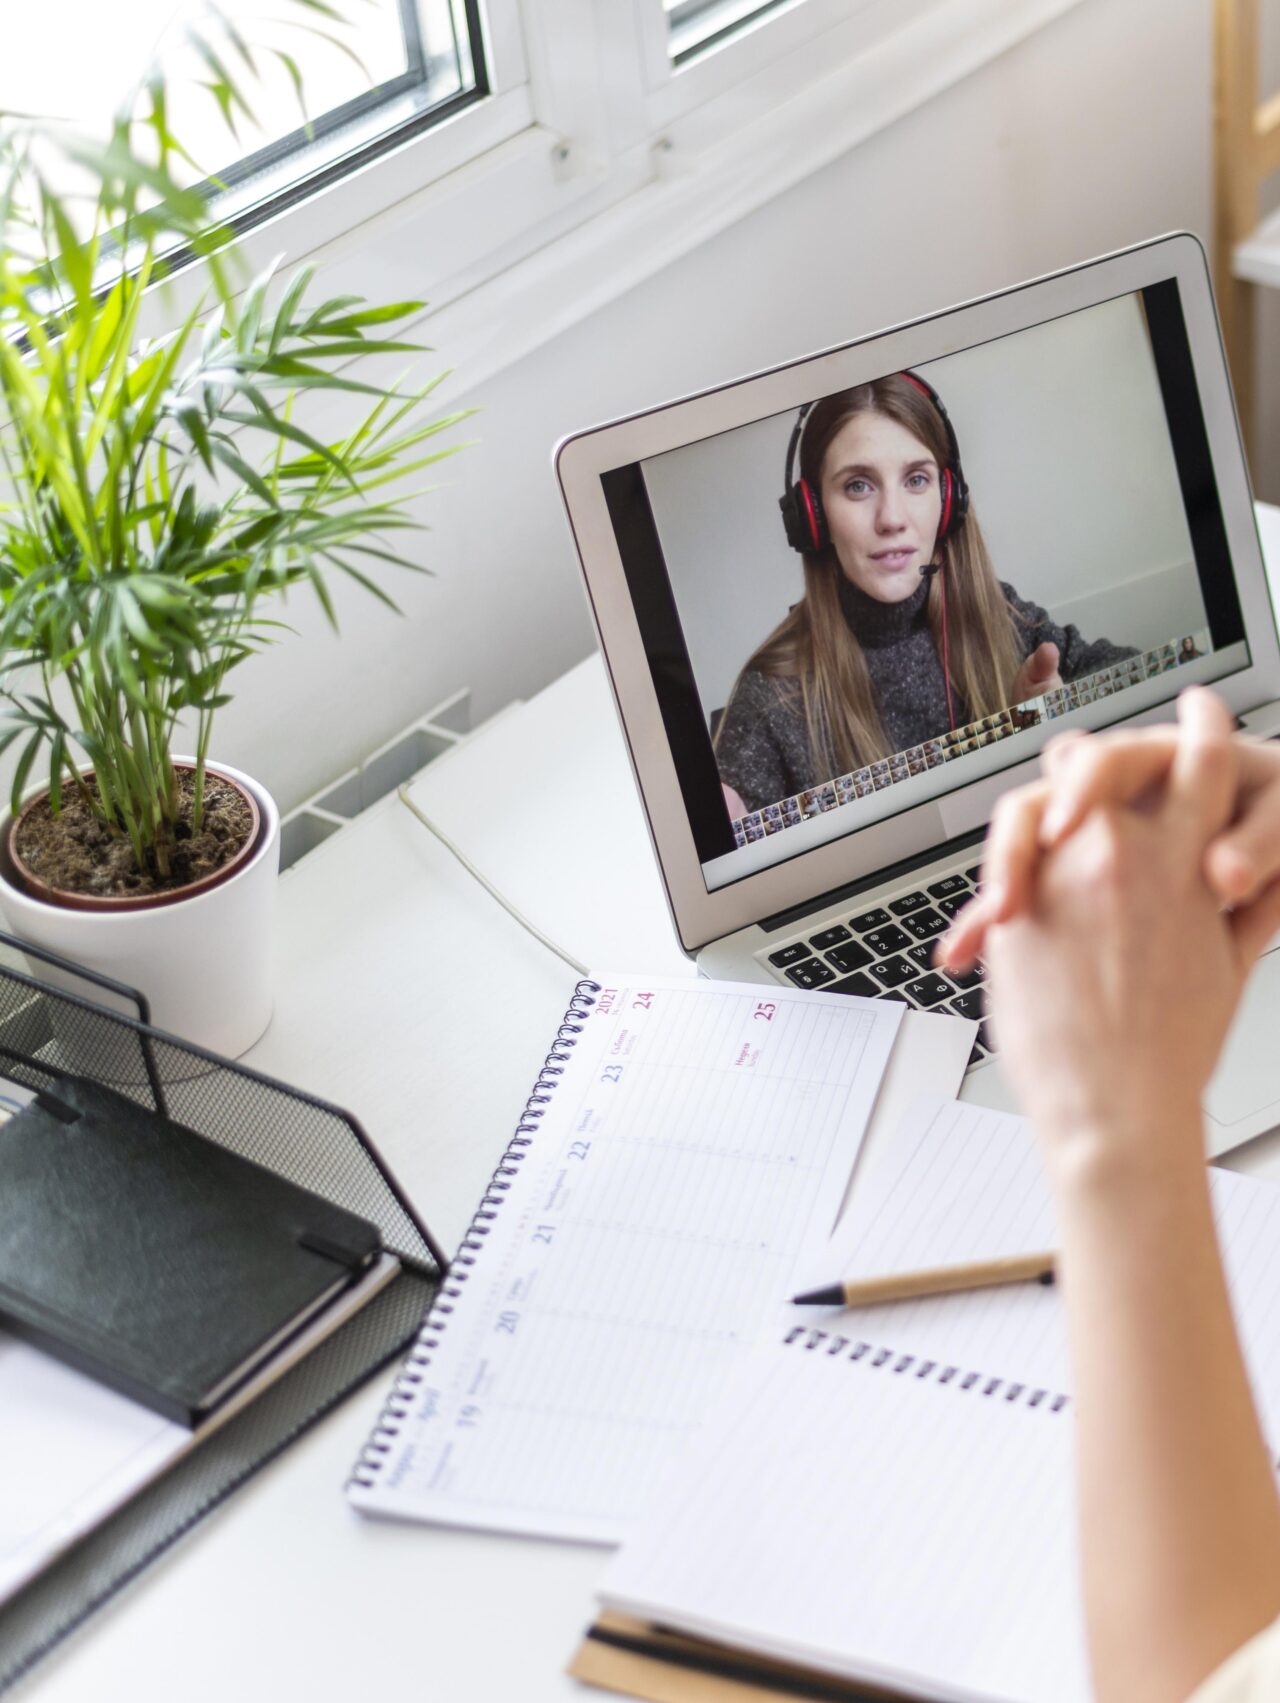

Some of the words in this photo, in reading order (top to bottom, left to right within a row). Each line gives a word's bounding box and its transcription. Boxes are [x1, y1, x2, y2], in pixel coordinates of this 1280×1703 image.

[916, 926, 926, 934] 3
[878, 942, 889, 950] 2
[783, 949, 797, 958] esc
[913, 947, 928, 957] W
[875, 965, 888, 974] Q
[900, 964, 914, 974] Й
[912, 984, 924, 993] A
[936, 984, 948, 992] Ф
[595, 988, 619, 1014] 2021
[632, 992, 655, 1009] 24
[956, 998, 969, 1007] Z
[753, 1003, 776, 1021] 25
[600, 1065, 624, 1083] 23
[567, 1141, 592, 1160] 22
[532, 1225, 556, 1244] 21
[494, 1311, 521, 1334] 20
